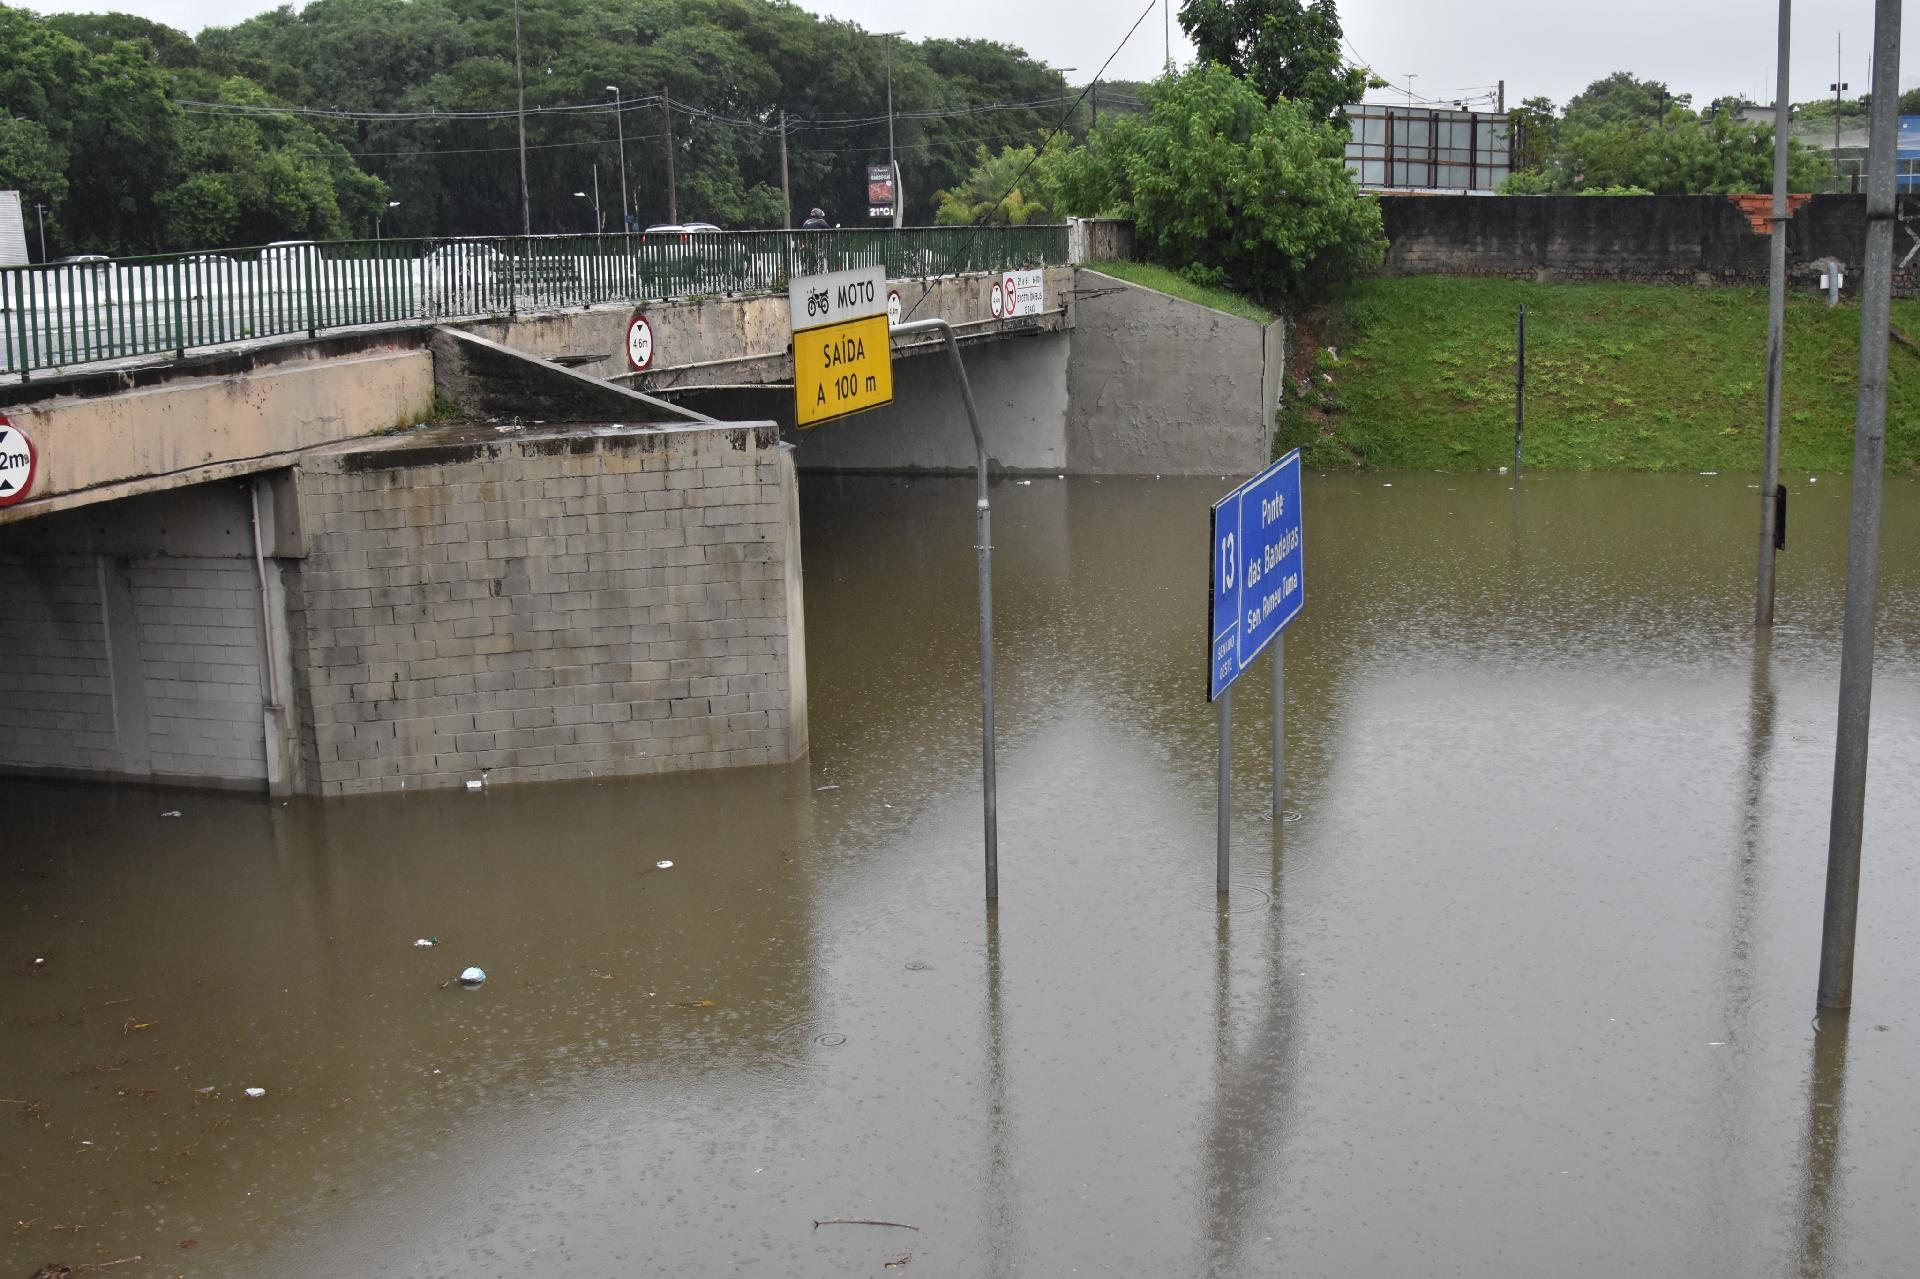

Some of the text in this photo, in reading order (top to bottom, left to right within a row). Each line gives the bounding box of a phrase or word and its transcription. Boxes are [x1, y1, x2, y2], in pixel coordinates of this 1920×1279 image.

[837, 280, 875, 309] MOTO
[823, 333, 866, 369] SAÍDA
[816, 372, 876, 406] A 100 m
[1261, 491, 1283, 530] Ponte
[1221, 531, 1235, 595] 13
[1247, 525, 1299, 589] das Bandeiras
[1247, 573, 1298, 634] Sen. Romeu Tuma
[1217, 634, 1235, 661] SENTIDO
